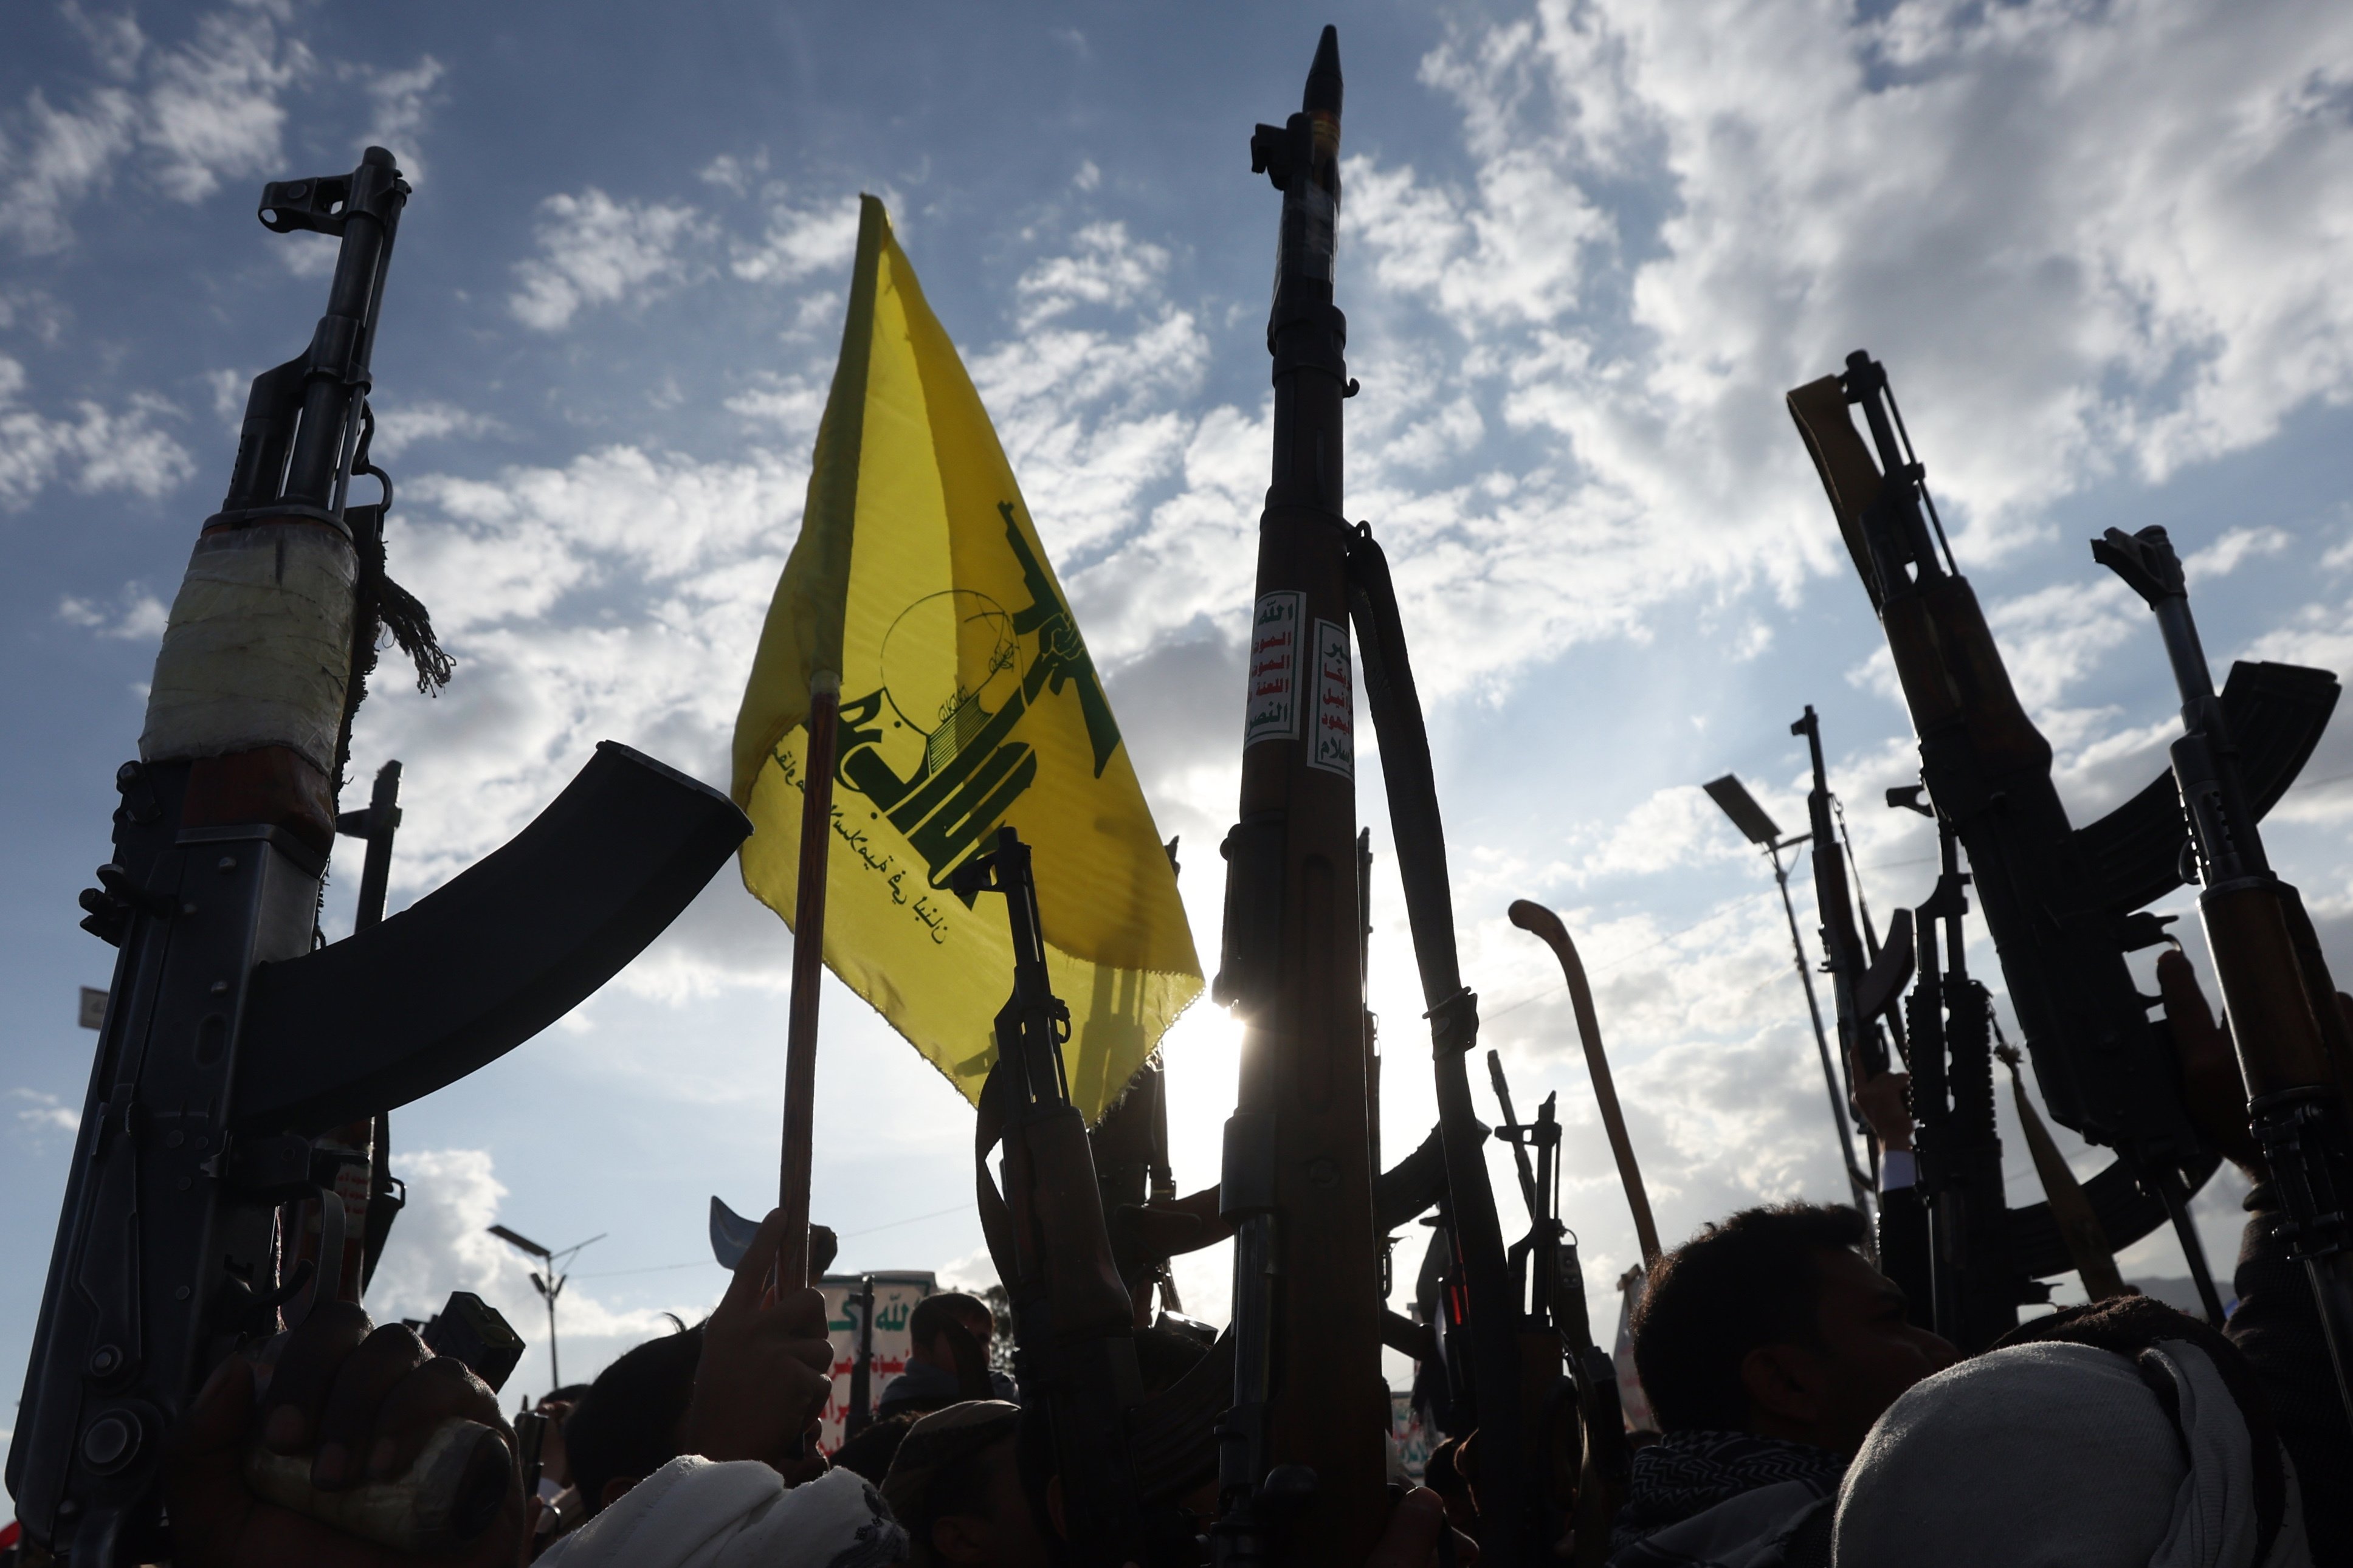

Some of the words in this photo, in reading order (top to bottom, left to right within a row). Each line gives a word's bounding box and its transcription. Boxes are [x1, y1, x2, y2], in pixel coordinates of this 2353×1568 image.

[1258, 599, 1293, 626] الله
[1253, 630, 1292, 655] الموت
[1251, 654, 1290, 678] الموت
[1255, 677, 1289, 696] اللعنة
[1247, 701, 1287, 737] النصر
